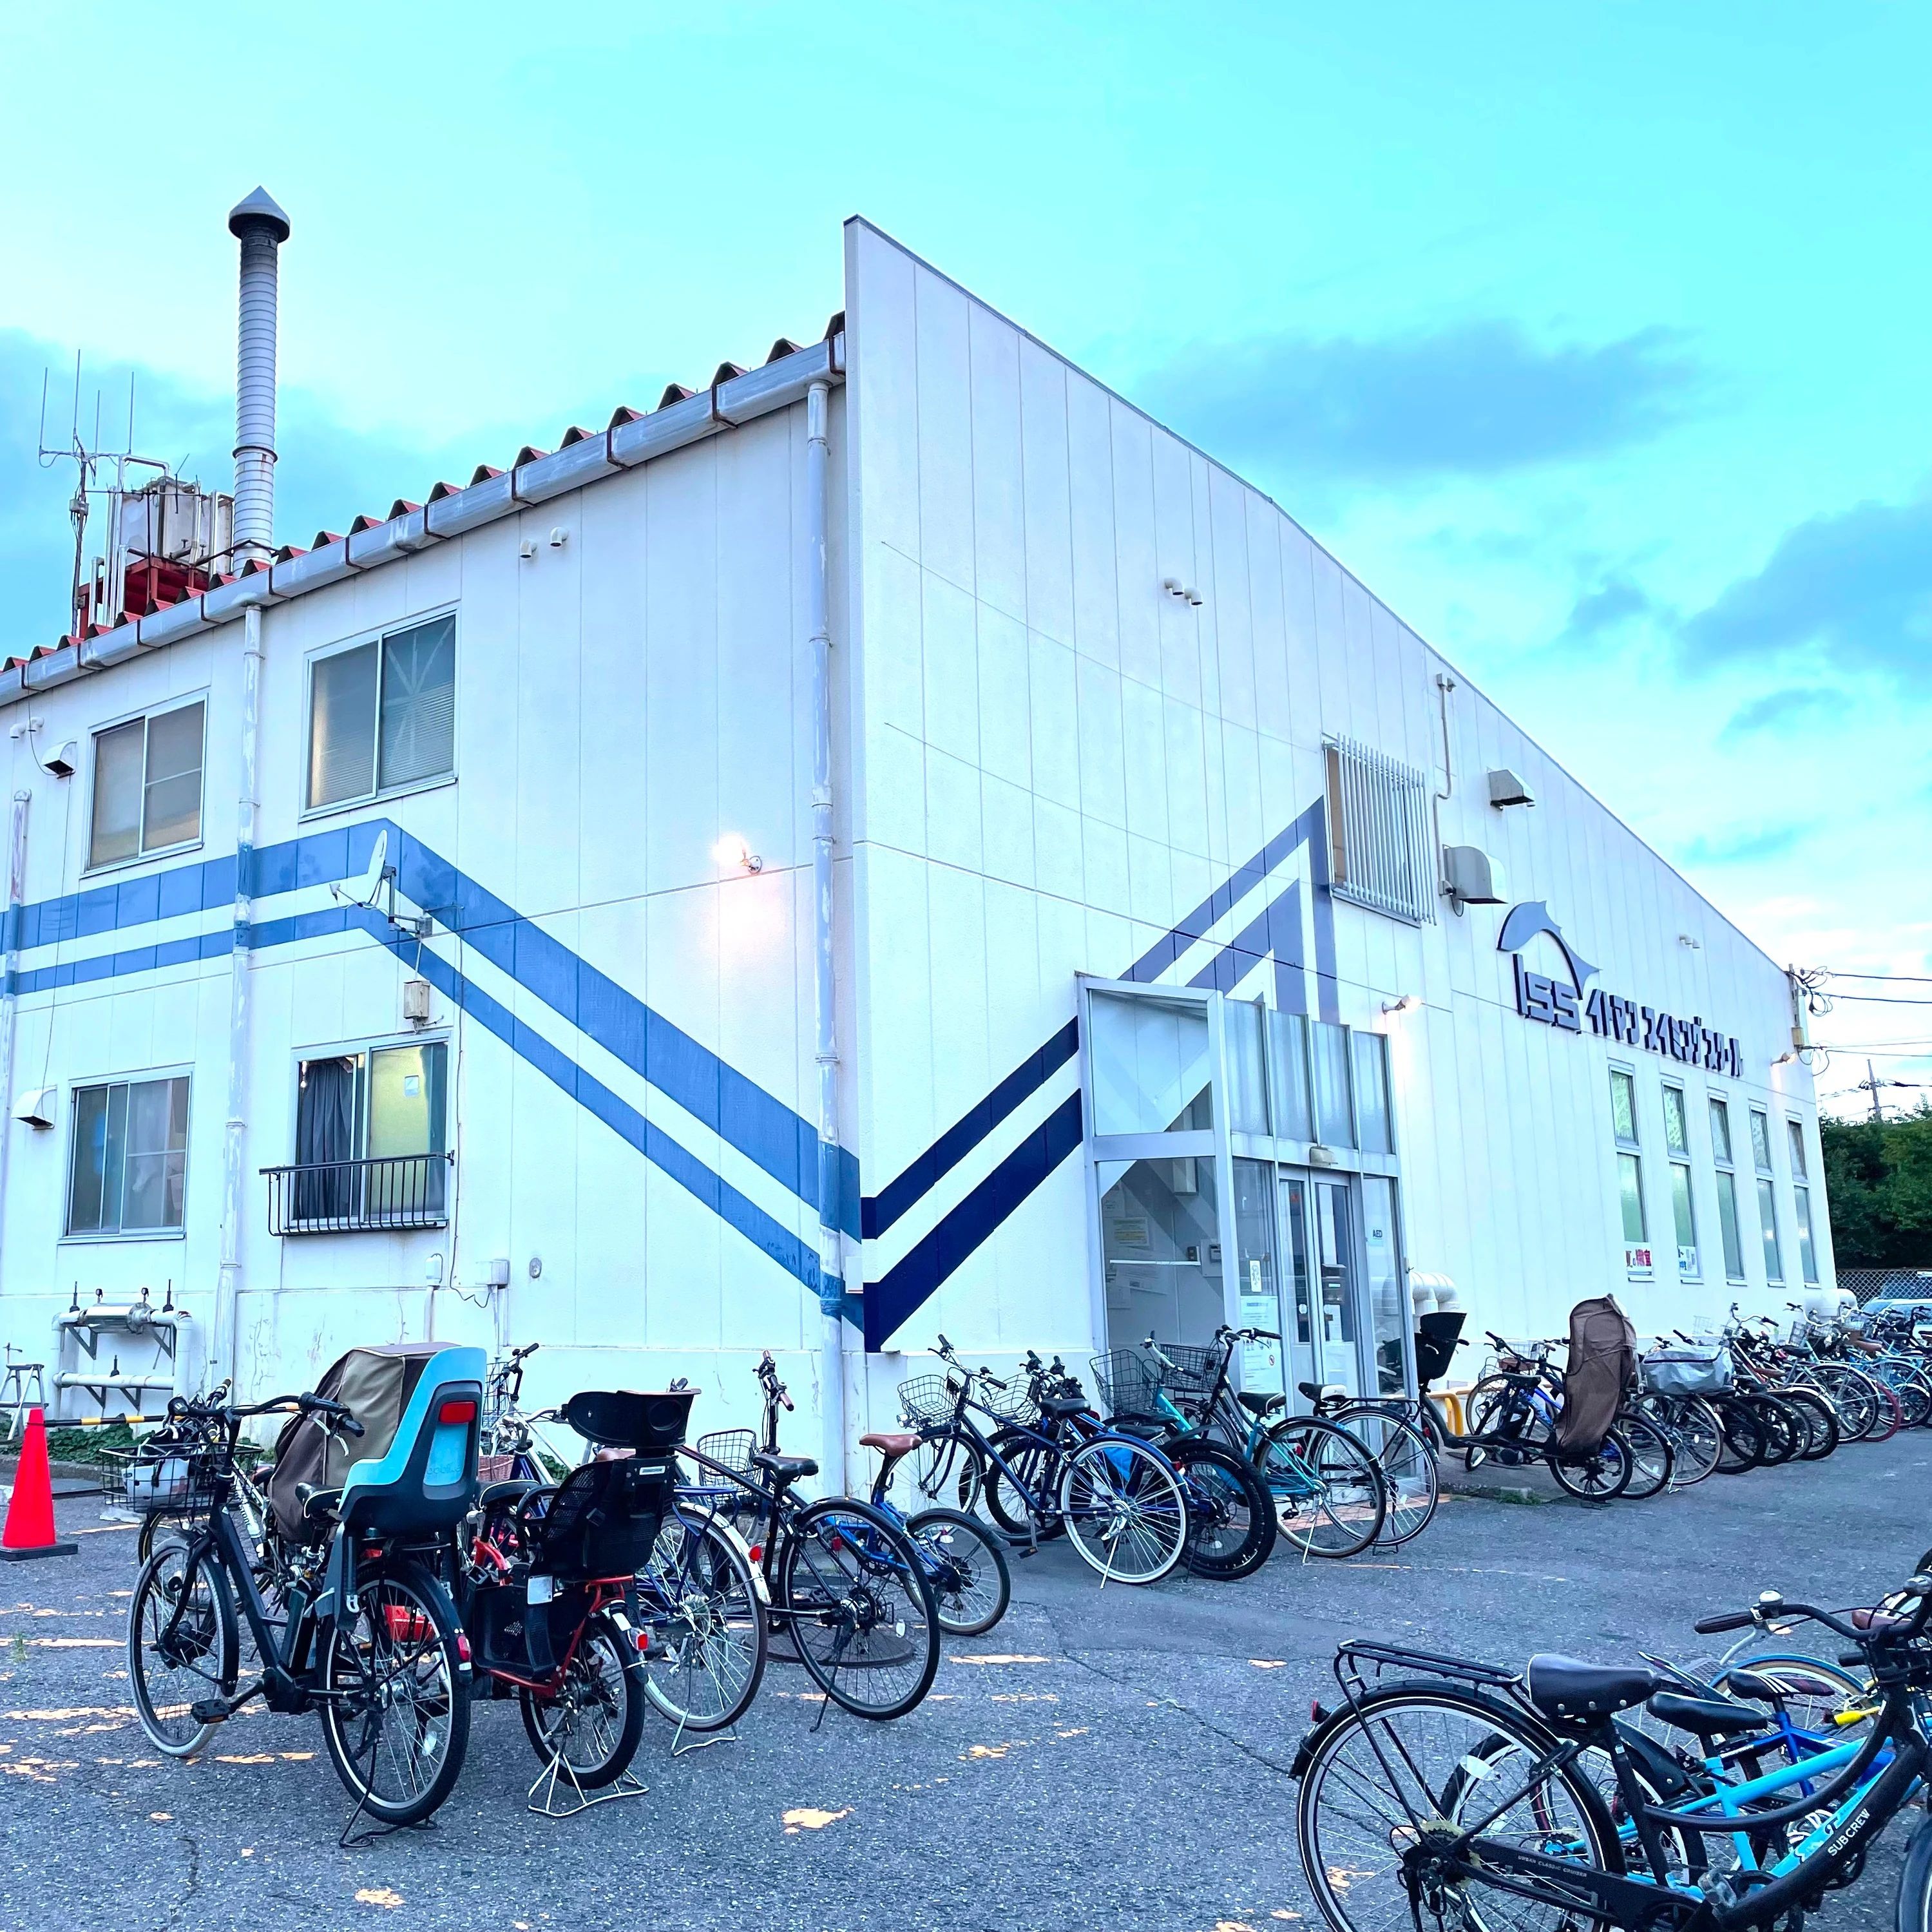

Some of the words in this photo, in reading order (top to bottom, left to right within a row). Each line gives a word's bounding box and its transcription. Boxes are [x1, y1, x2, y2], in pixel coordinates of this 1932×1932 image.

[1513, 953, 1582, 1035] ISS
[1373, 1229, 1382, 1238] AED
[1828, 1835, 1849, 1856] SUB
[1845, 1808, 1870, 1838] CREW
